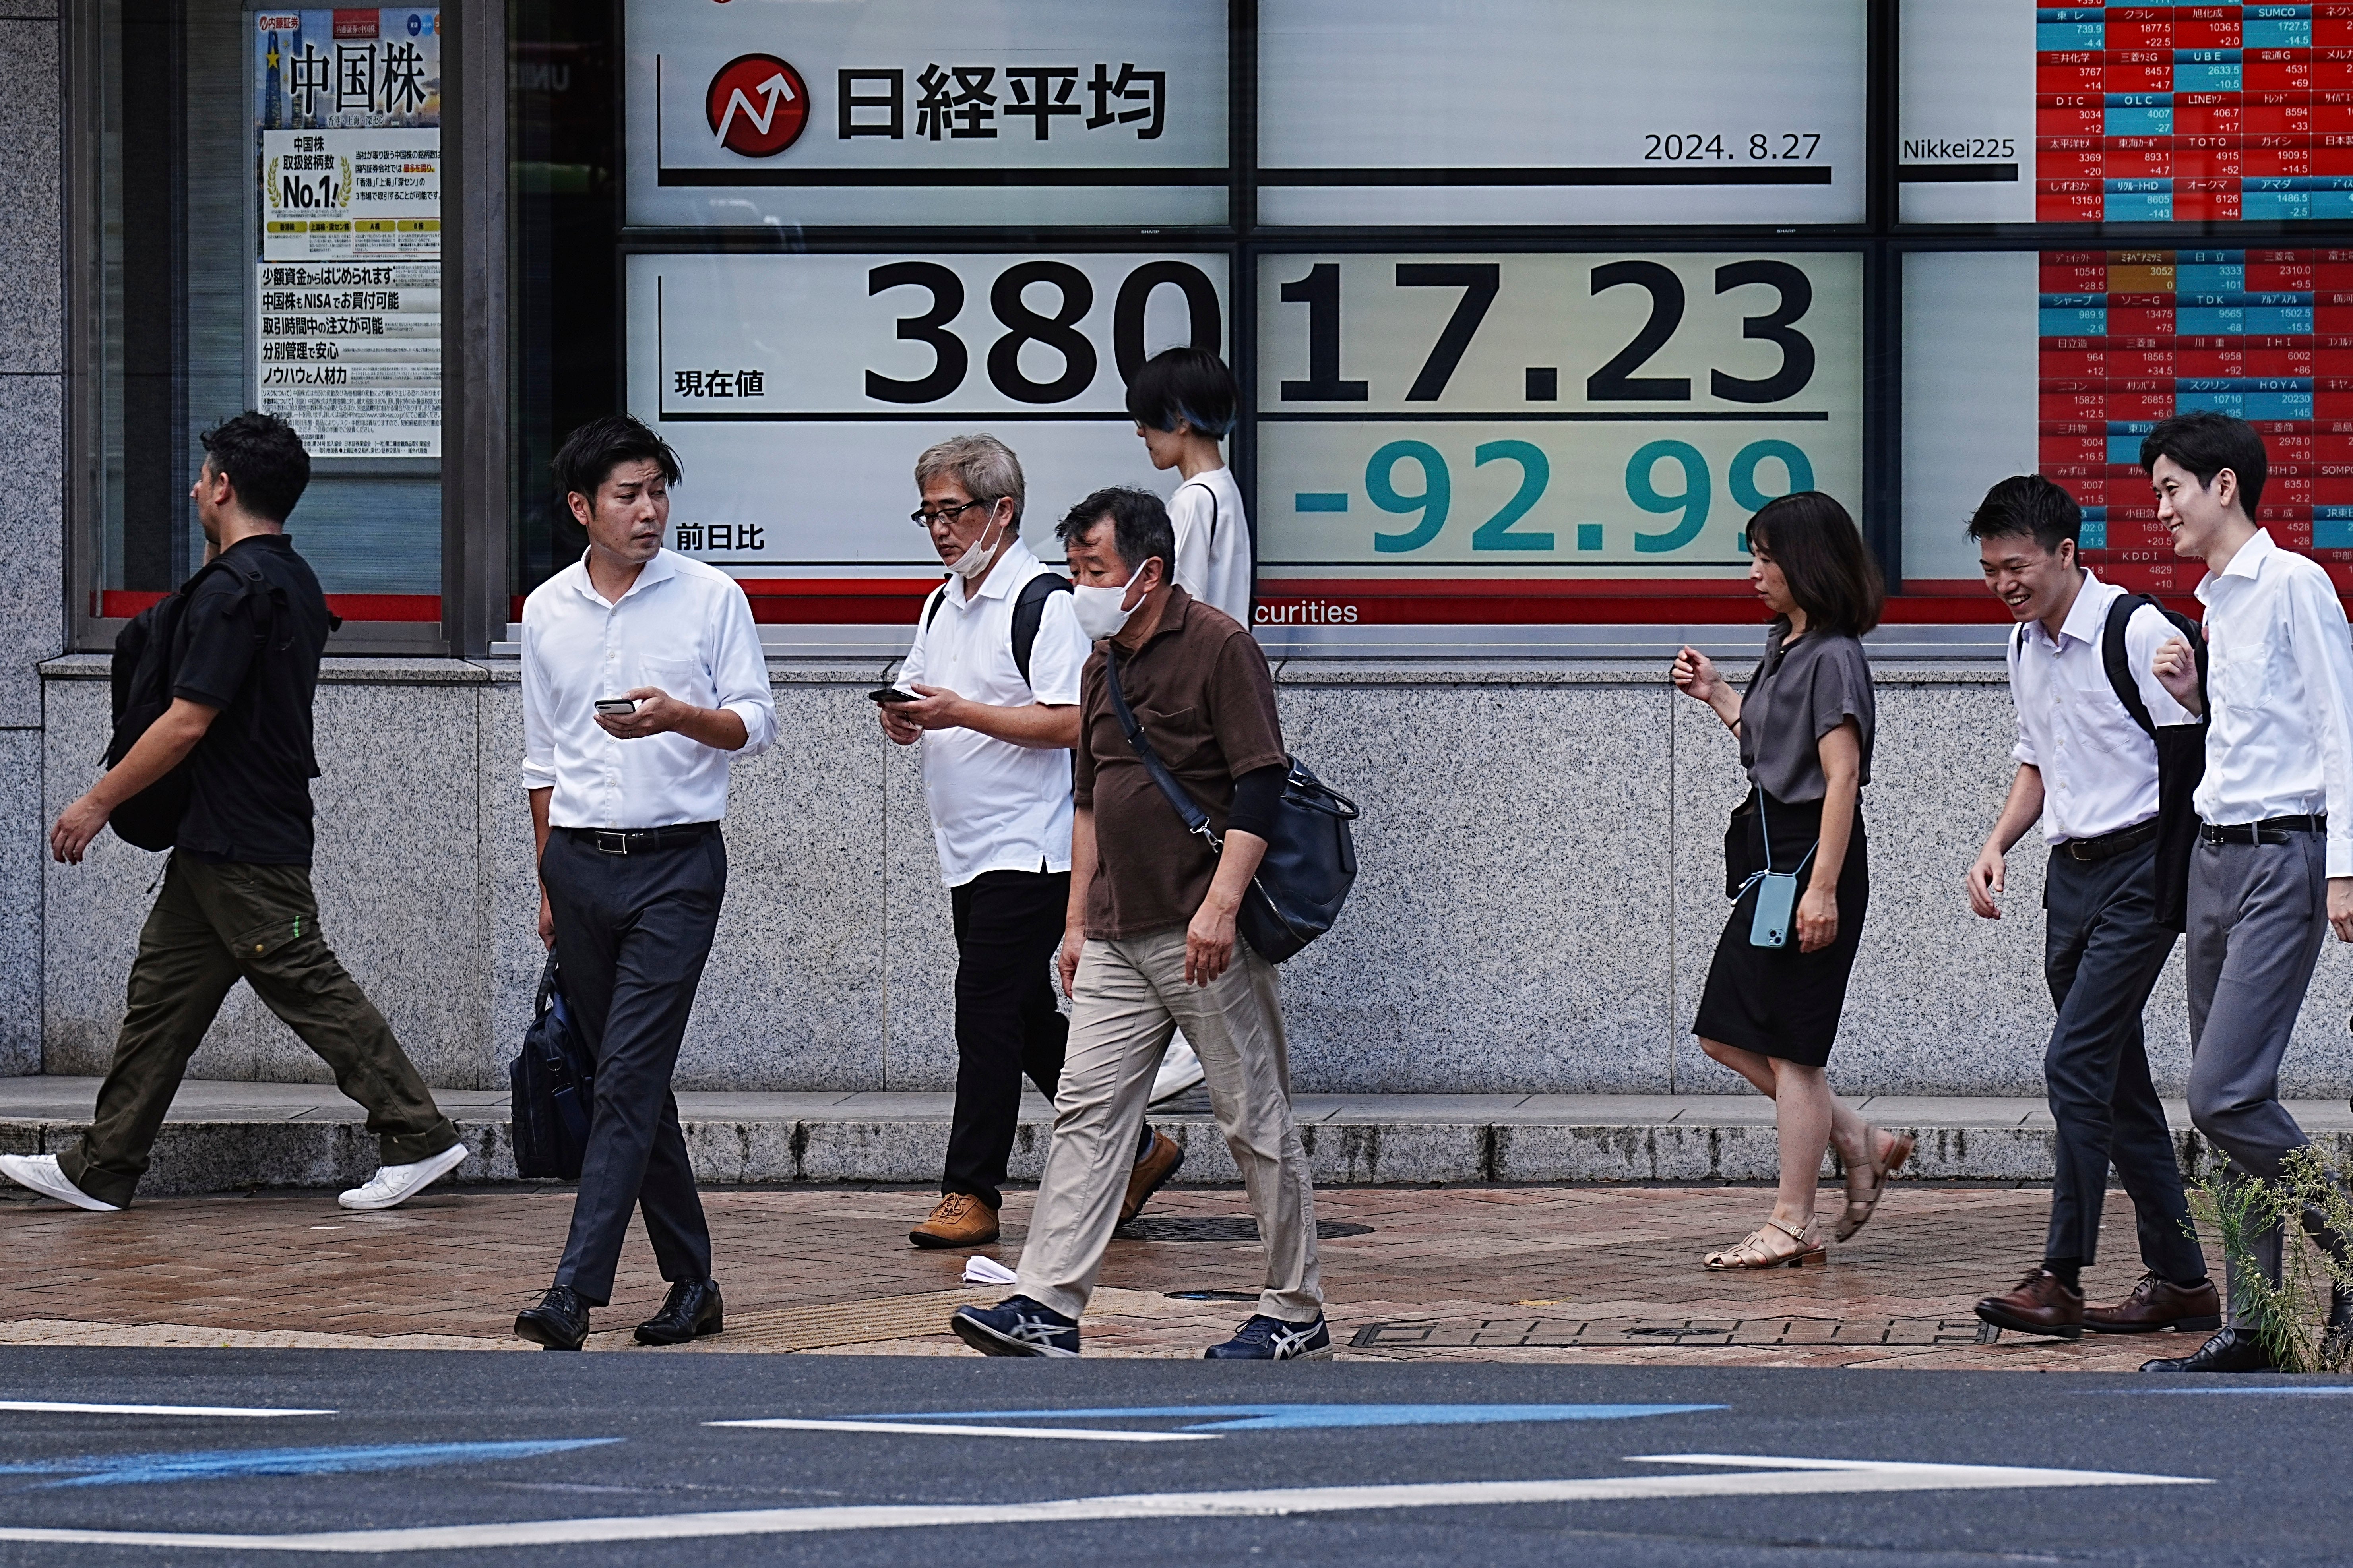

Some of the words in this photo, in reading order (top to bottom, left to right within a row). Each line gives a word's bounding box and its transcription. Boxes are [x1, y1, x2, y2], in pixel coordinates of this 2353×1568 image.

[2124, 10, 2154, 19] クラレ
[2192, 8, 2223, 18] 旭化成
[2258, 8, 2295, 17] SUMCO
[2077, 24, 2102, 33] 739.9
[2140, 23, 2171, 33] 1877.5
[2210, 22, 2239, 32] 1036.5
[2278, 21, 2309, 31] 1727.5
[2084, 39, 2102, 48] -4.4
[2145, 37, 2171, 47] +22.5
[2219, 37, 2239, 46] +2.0
[2285, 35, 2308, 45] -14.5
[2051, 52, 2090, 63] 三井化学
[2079, 67, 2101, 76] 3767
[2145, 66, 2170, 75] 845.7
[2208, 66, 2239, 75] 2633.5
[2285, 65, 2307, 74] 4531
[290, 42, 426, 114] 中国株
[2085, 81, 2101, 90] +14
[2150, 80, 2170, 89] +4.7
[2216, 79, 2239, 89] -10.5
[2291, 79, 2308, 87] +69
[838, 62, 1165, 141] 日経平均
[2079, 110, 2101, 119] 3034
[2147, 109, 2170, 118] 4007
[2213, 108, 2239, 118] 406.7
[2285, 108, 2308, 116] 8594
[2084, 124, 2101, 133] +12
[2155, 123, 2170, 133] -27
[2219, 122, 2239, 131] +1.7
[2291, 122, 2308, 131] +33
[294, 136, 324, 153] 中国株
[2261, 136, 2291, 147] ガイシ
[1749, 134, 1820, 160] 8.27
[1903, 139, 2015, 158] Nikkei225
[2079, 153, 2101, 162] 3369
[2144, 152, 2169, 161] 893.1
[2216, 151, 2239, 160] 4915
[2277, 151, 2308, 159] 1909.5
[283, 154, 335, 170] 取扱銘柄数
[2084, 167, 2101, 176] +20
[2150, 166, 2170, 175] +4.7
[2222, 165, 2239, 174] +52
[2282, 165, 2308, 173] +14.5
[2051, 181, 2090, 191] しずおか
[2187, 180, 2227, 190] オークマ
[2262, 179, 2291, 189] アマダ
[283, 175, 339, 208] No.1!
[2071, 196, 2101, 205] 1315.0
[2147, 195, 2170, 204] 8605
[2216, 194, 2239, 203] 6126
[2277, 194, 2308, 203] 1486.5
[2081, 210, 2101, 219] +4.5
[2149, 209, 2170, 218] -143
[2221, 208, 2238, 217] +44
[2290, 207, 2308, 217] -2.5
[2265, 251, 2295, 261] 三菱電
[2075, 267, 2104, 276] 1054.0
[2151, 267, 2173, 276] 3052
[2219, 266, 2242, 275] 3333
[2280, 266, 2311, 275] 2310.0
[262, 267, 393, 286] 少額資金からはじめられます
[2079, 281, 2104, 290] +28.5
[2167, 281, 2173, 290] 0
[2221, 280, 2241, 289] -101
[2291, 279, 2311, 289] +9.5
[263, 291, 399, 311] 中国株もNISAでお買付可能
[2053, 294, 2093, 305] シャープ
[2122, 296, 2160, 305] ソニーG
[2079, 310, 2104, 319] 989.9
[2146, 310, 2173, 318] 13475
[2219, 309, 2242, 318] 9565
[2280, 308, 2311, 317] 1502.5
[263, 316, 384, 335] 取引時間中の注文が可能
[2086, 324, 2105, 333] -2.9
[2156, 323, 2173, 332] +75
[2227, 323, 2242, 332] -68
[2287, 322, 2311, 332] -15.5
[2058, 339, 2087, 348] 日立造
[2126, 338, 2156, 348] 三菱重
[263, 342, 339, 360] 分別管理で安心
[2287, 351, 2310, 360] 6002
[2087, 353, 2103, 362] 964
[2143, 352, 2173, 361] 1856.5
[2219, 352, 2241, 361] 4958
[2087, 366, 2104, 376] +12
[2147, 366, 2173, 375] +34.5
[2225, 366, 2241, 375] +92
[2294, 365, 2310, 374] +86
[264, 366, 347, 385] ノウハウと人材力
[675, 369, 764, 397] 現在値
[2058, 382, 2087, 391] ニコン
[2190, 380, 2230, 390] スクリン
[2074, 395, 2104, 404] 1582.5
[2142, 395, 2173, 404] 2685.5
[2214, 395, 2241, 404] 10710
[2282, 394, 2310, 403] 20230
[2079, 409, 2104, 418] +12.5
[2153, 409, 2173, 418] +6.0
[2290, 408, 2310, 418] -145
[2058, 423, 2087, 433] 三井物
[2264, 422, 2293, 433] 三菱商
[2082, 438, 2103, 447] 3004
[2279, 437, 2310, 446] 2978.0
[2078, 452, 2104, 461] +16.5
[2290, 451, 2310, 460] +6.0
[2057, 466, 2087, 476] みずほ
[2082, 480, 2103, 489] 3007
[2285, 480, 2310, 489] 835.0
[2079, 494, 2103, 503] +11.5
[2290, 494, 2310, 503] +2.2
[2126, 508, 2156, 519] 小田急
[2287, 522, 2310, 532] 4528
[676, 522, 764, 551] 前日比
[2147, 536, 2172, 546] +20.5
[2086, 537, 2104, 546] -1.5
[2294, 537, 2310, 546] +28
[2149, 565, 2172, 574] 4829
[2155, 580, 2172, 588] +10
